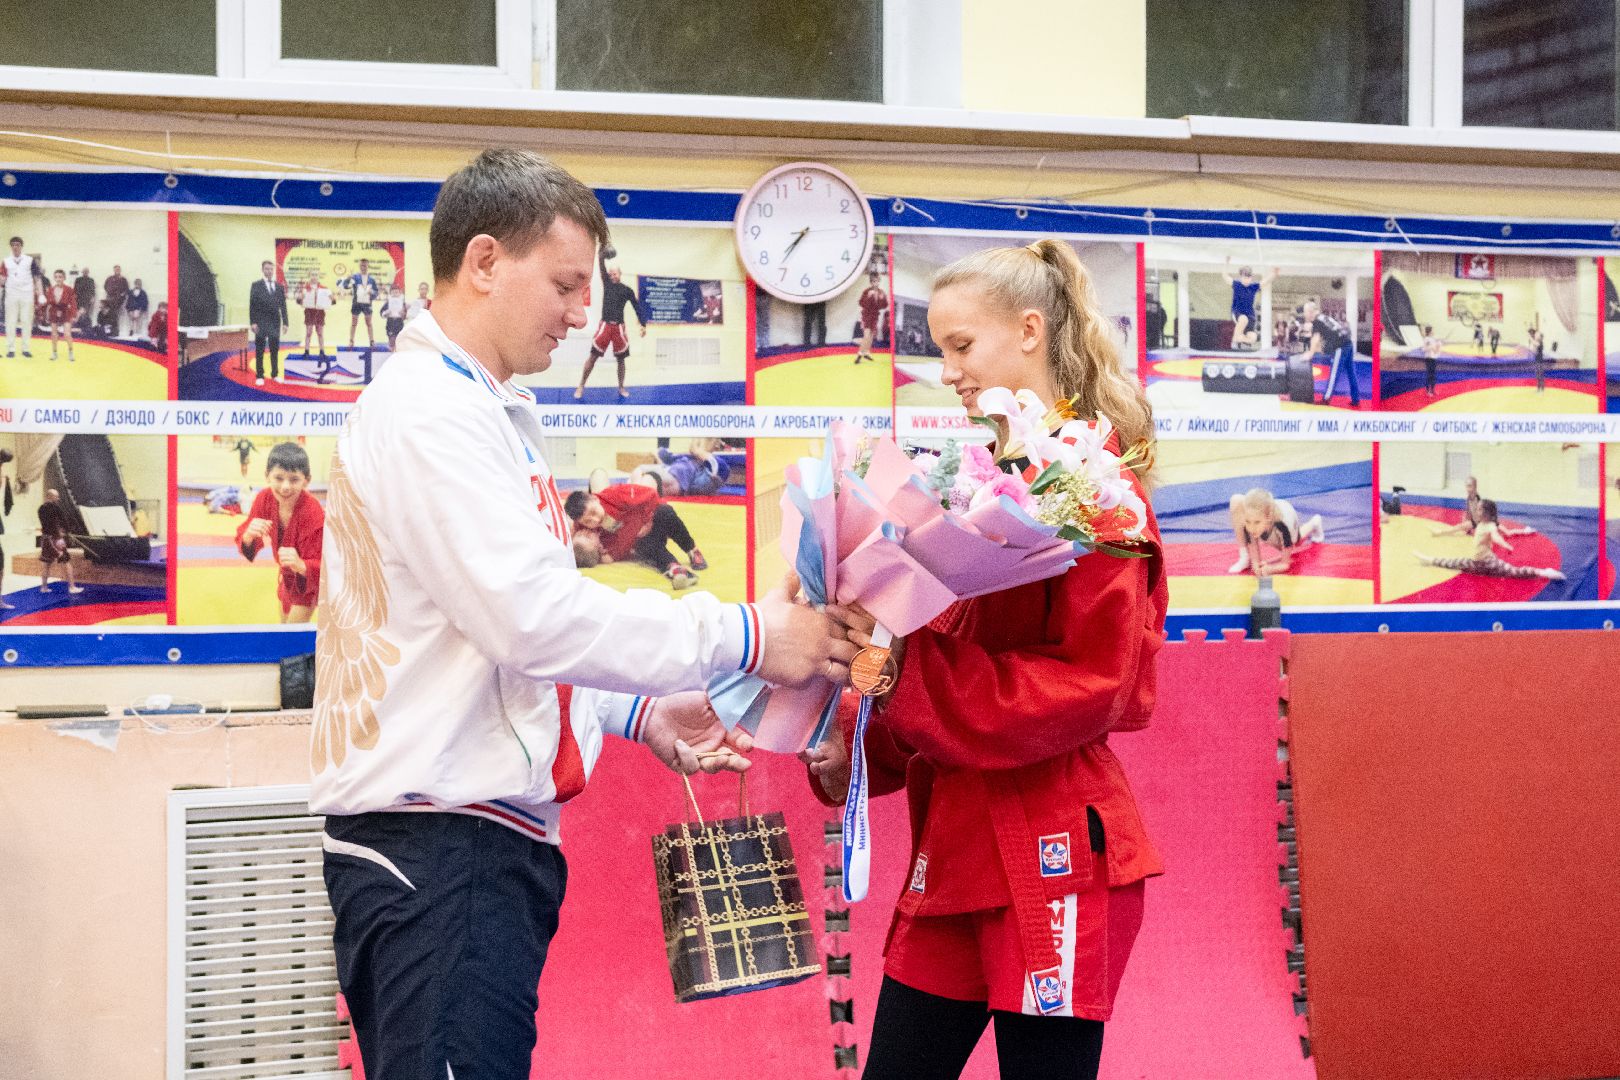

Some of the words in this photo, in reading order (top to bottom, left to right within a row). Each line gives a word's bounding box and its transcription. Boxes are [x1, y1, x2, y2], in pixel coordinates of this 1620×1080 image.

[796, 176, 813, 190] 12
[775, 184, 787, 198] 11
[826, 184, 831, 197] 1
[757, 203, 773, 217] 10
[840, 199, 849, 213] 2
[750, 225, 760, 239] 9
[849, 225, 858, 238] 3
[759, 250, 768, 264] 8
[841, 250, 850, 262] 4
[778, 268, 787, 281] 7
[800, 273, 810, 287] 6
[825, 266, 834, 280] 5
[35, 409, 80, 424] САМБО
[105, 410, 155, 427] ДЗЮДО
[176, 410, 210, 426] БОКС
[231, 408, 283, 427] АЙКИДО
[541, 413, 597, 428] ФИТБОКС
[616, 414, 671, 428] ЖЕНСКАЯ
[674, 415, 755, 429] САМООБОРОНА
[1154, 419, 1171, 432] ОКС
[1188, 416, 1229, 433] АЙКИДО
[1245, 419, 1301, 433] ГРЭППЛИНГ
[1317, 420, 1339, 433] ММА
[1353, 420, 1416, 434] КИКБОКСИНГ
[1433, 420, 1477, 434] ФИТБОКС
[1492, 420, 1536, 434] ЖЕНСКАЯ
[1539, 421, 1606, 435] САМООБОРОНА
